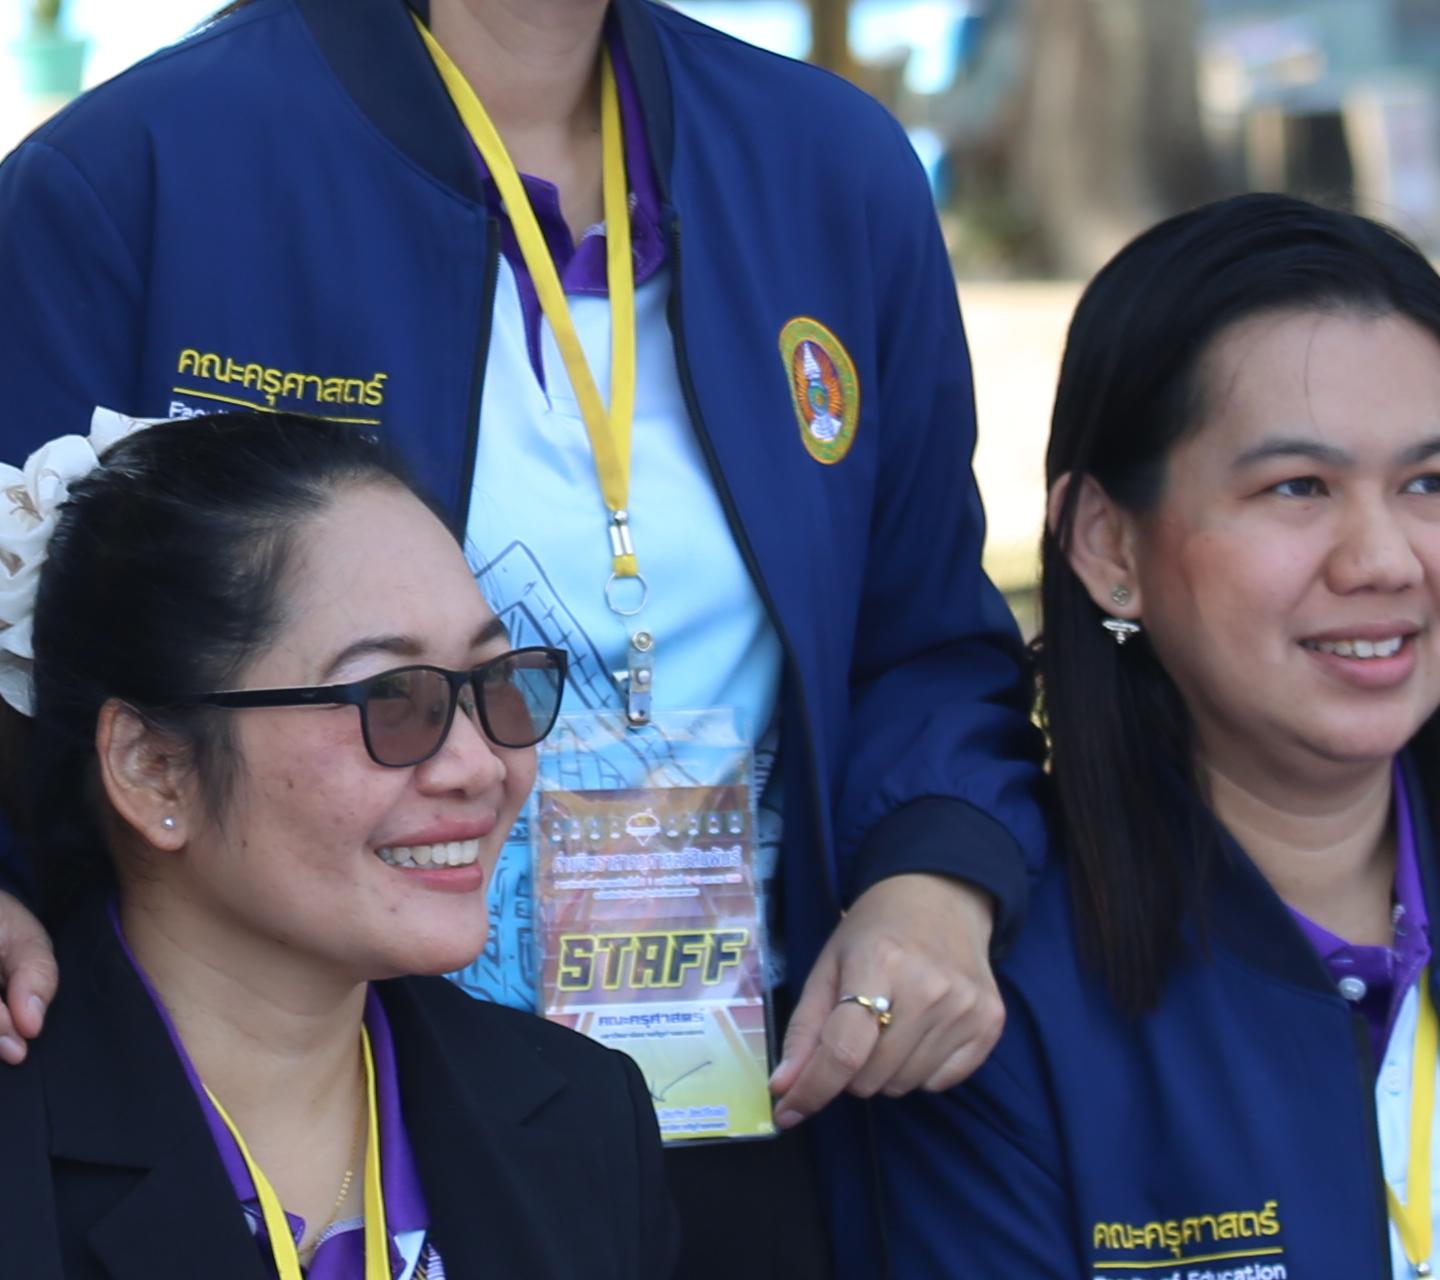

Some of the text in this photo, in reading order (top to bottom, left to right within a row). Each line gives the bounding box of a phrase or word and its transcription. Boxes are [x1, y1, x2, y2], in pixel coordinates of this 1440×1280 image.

[177, 348, 388, 407] คณะครุศาสตร์
[558, 928, 749, 991] STAFF
[1093, 1200, 1280, 1258] คณะครุศาสตร์
